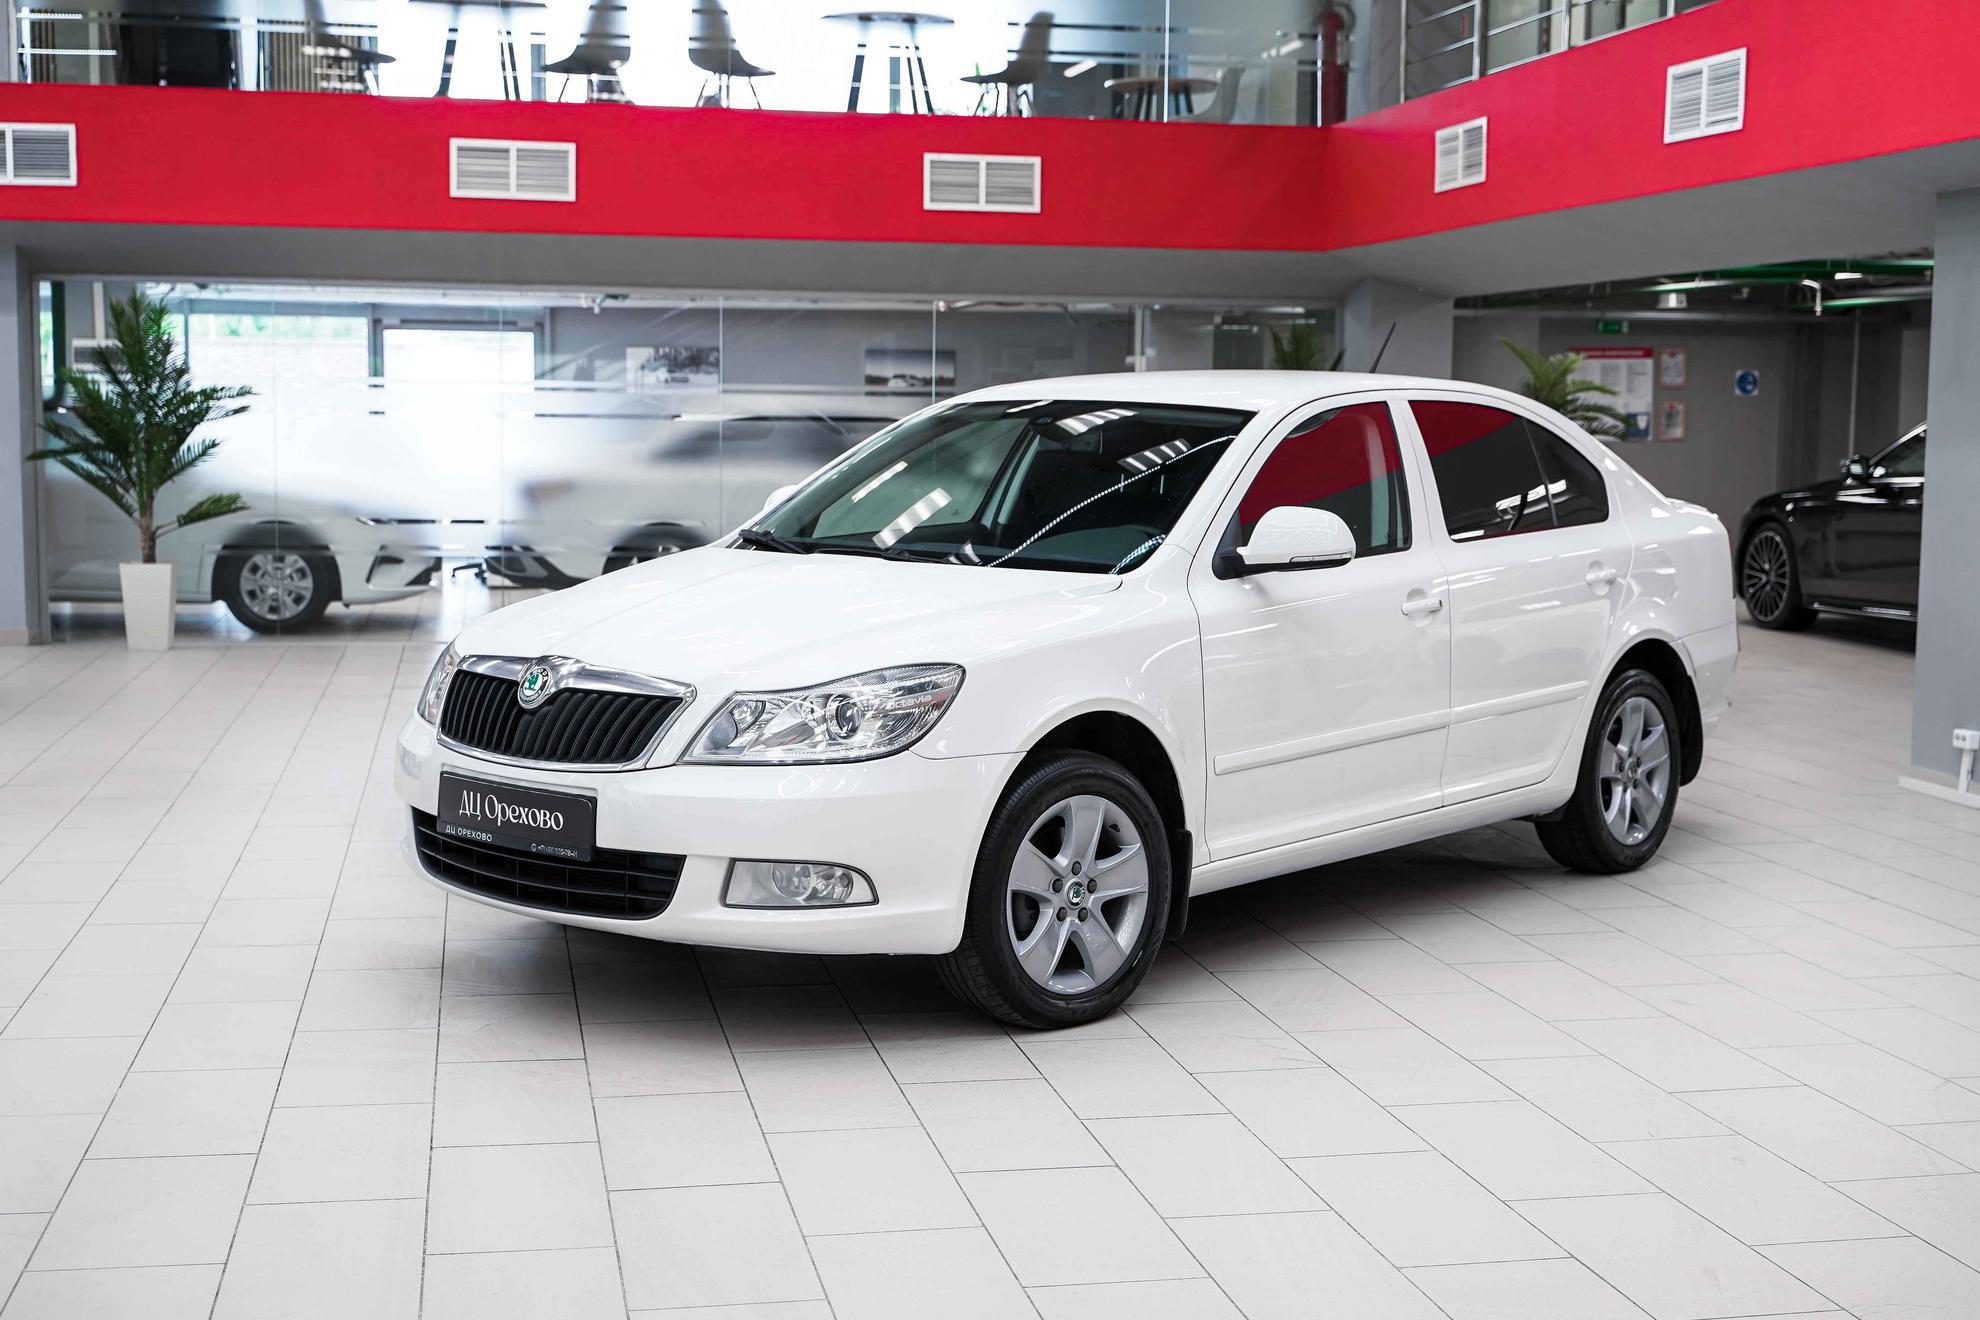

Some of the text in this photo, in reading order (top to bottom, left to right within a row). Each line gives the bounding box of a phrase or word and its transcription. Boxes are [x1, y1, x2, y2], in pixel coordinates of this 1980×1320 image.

[459, 789, 564, 831] ДЦ Орехово
[445, 825, 493, 842] ДЦ ОРЕХОВО
